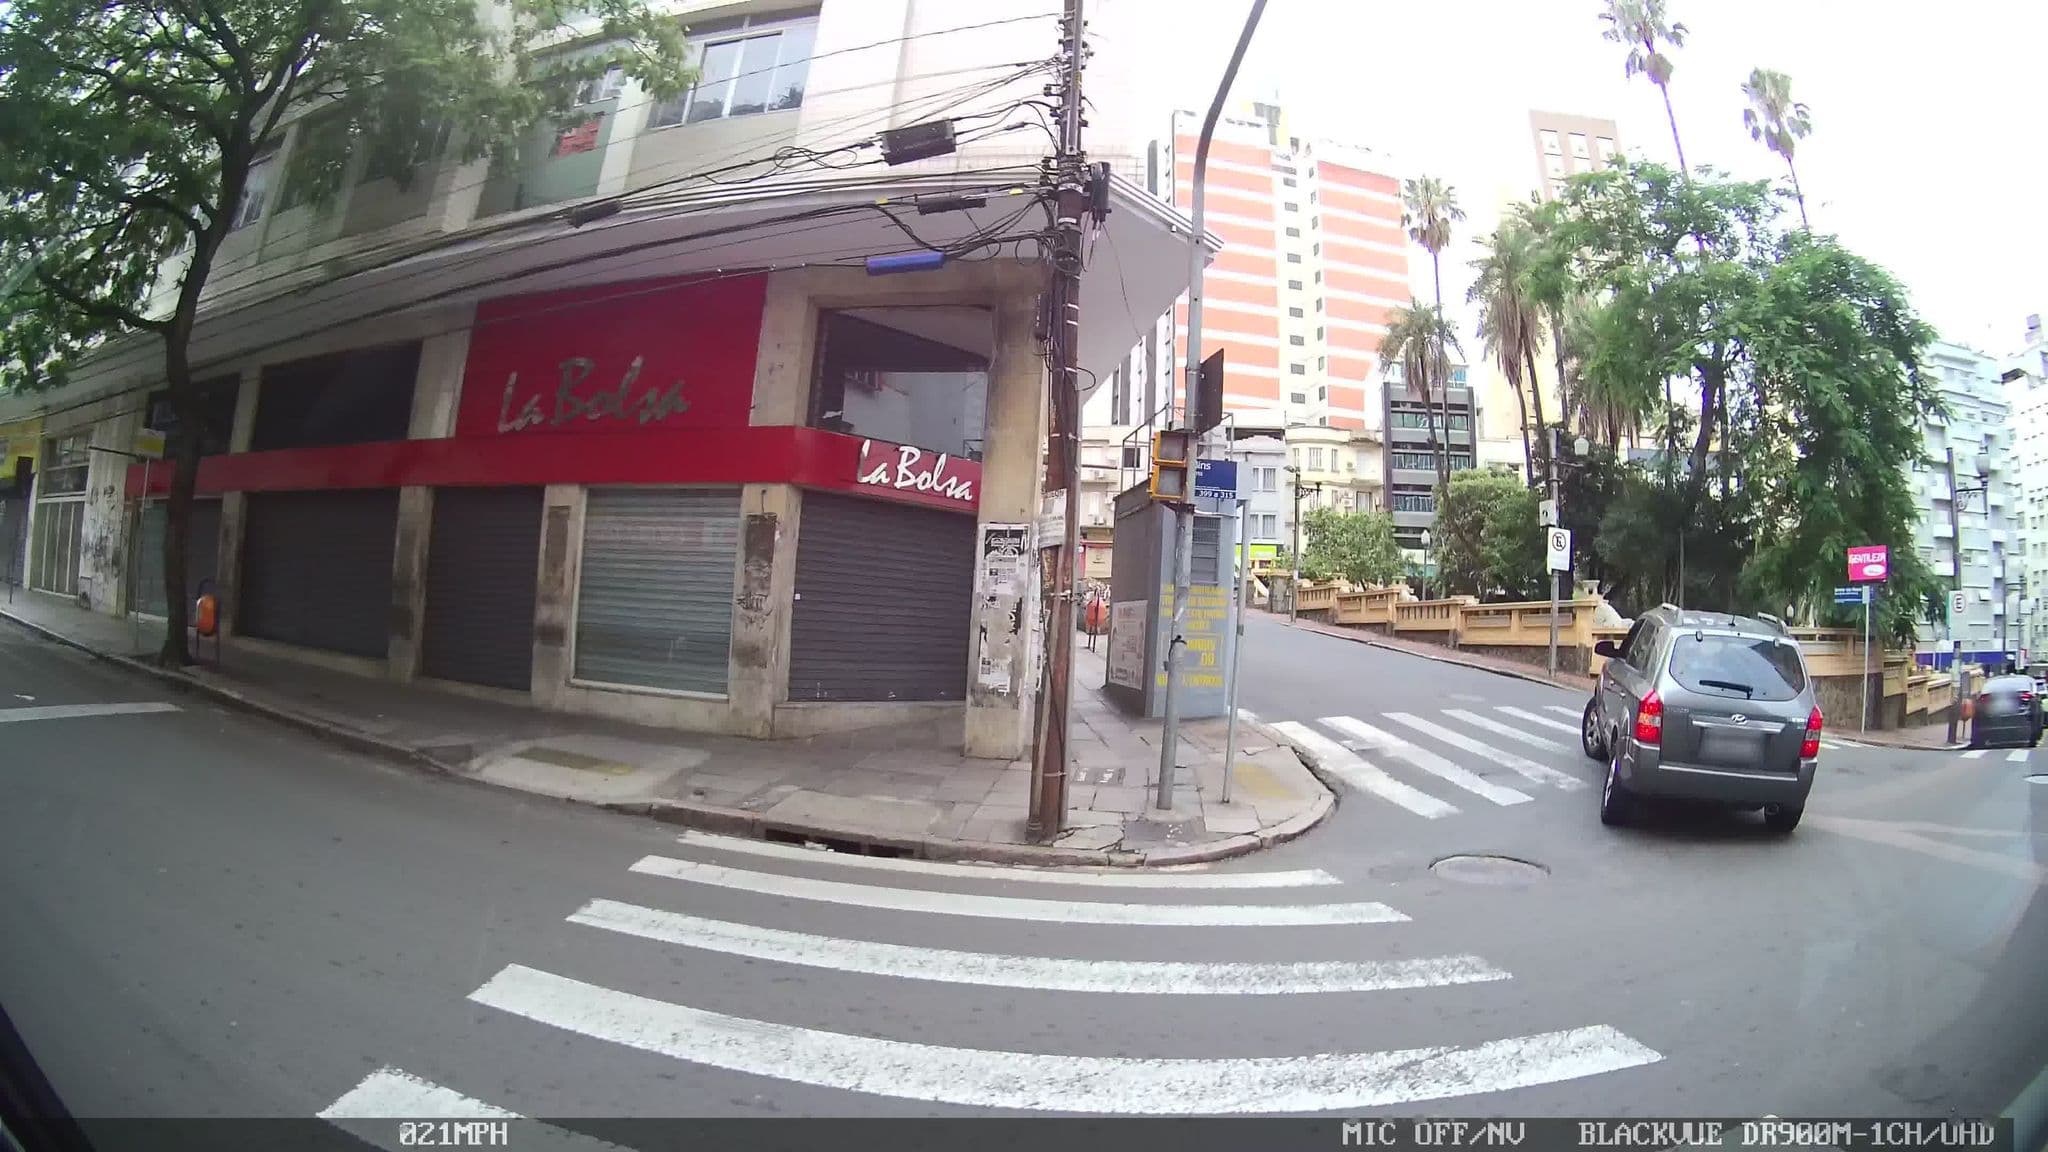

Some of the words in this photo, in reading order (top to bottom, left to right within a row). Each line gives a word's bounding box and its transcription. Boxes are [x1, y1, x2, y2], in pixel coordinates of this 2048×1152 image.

[498, 371, 544, 432] La
[551, 355, 691, 425] Bolsa
[857, 439, 890, 484] La
[894, 446, 973, 500] Bolsa
